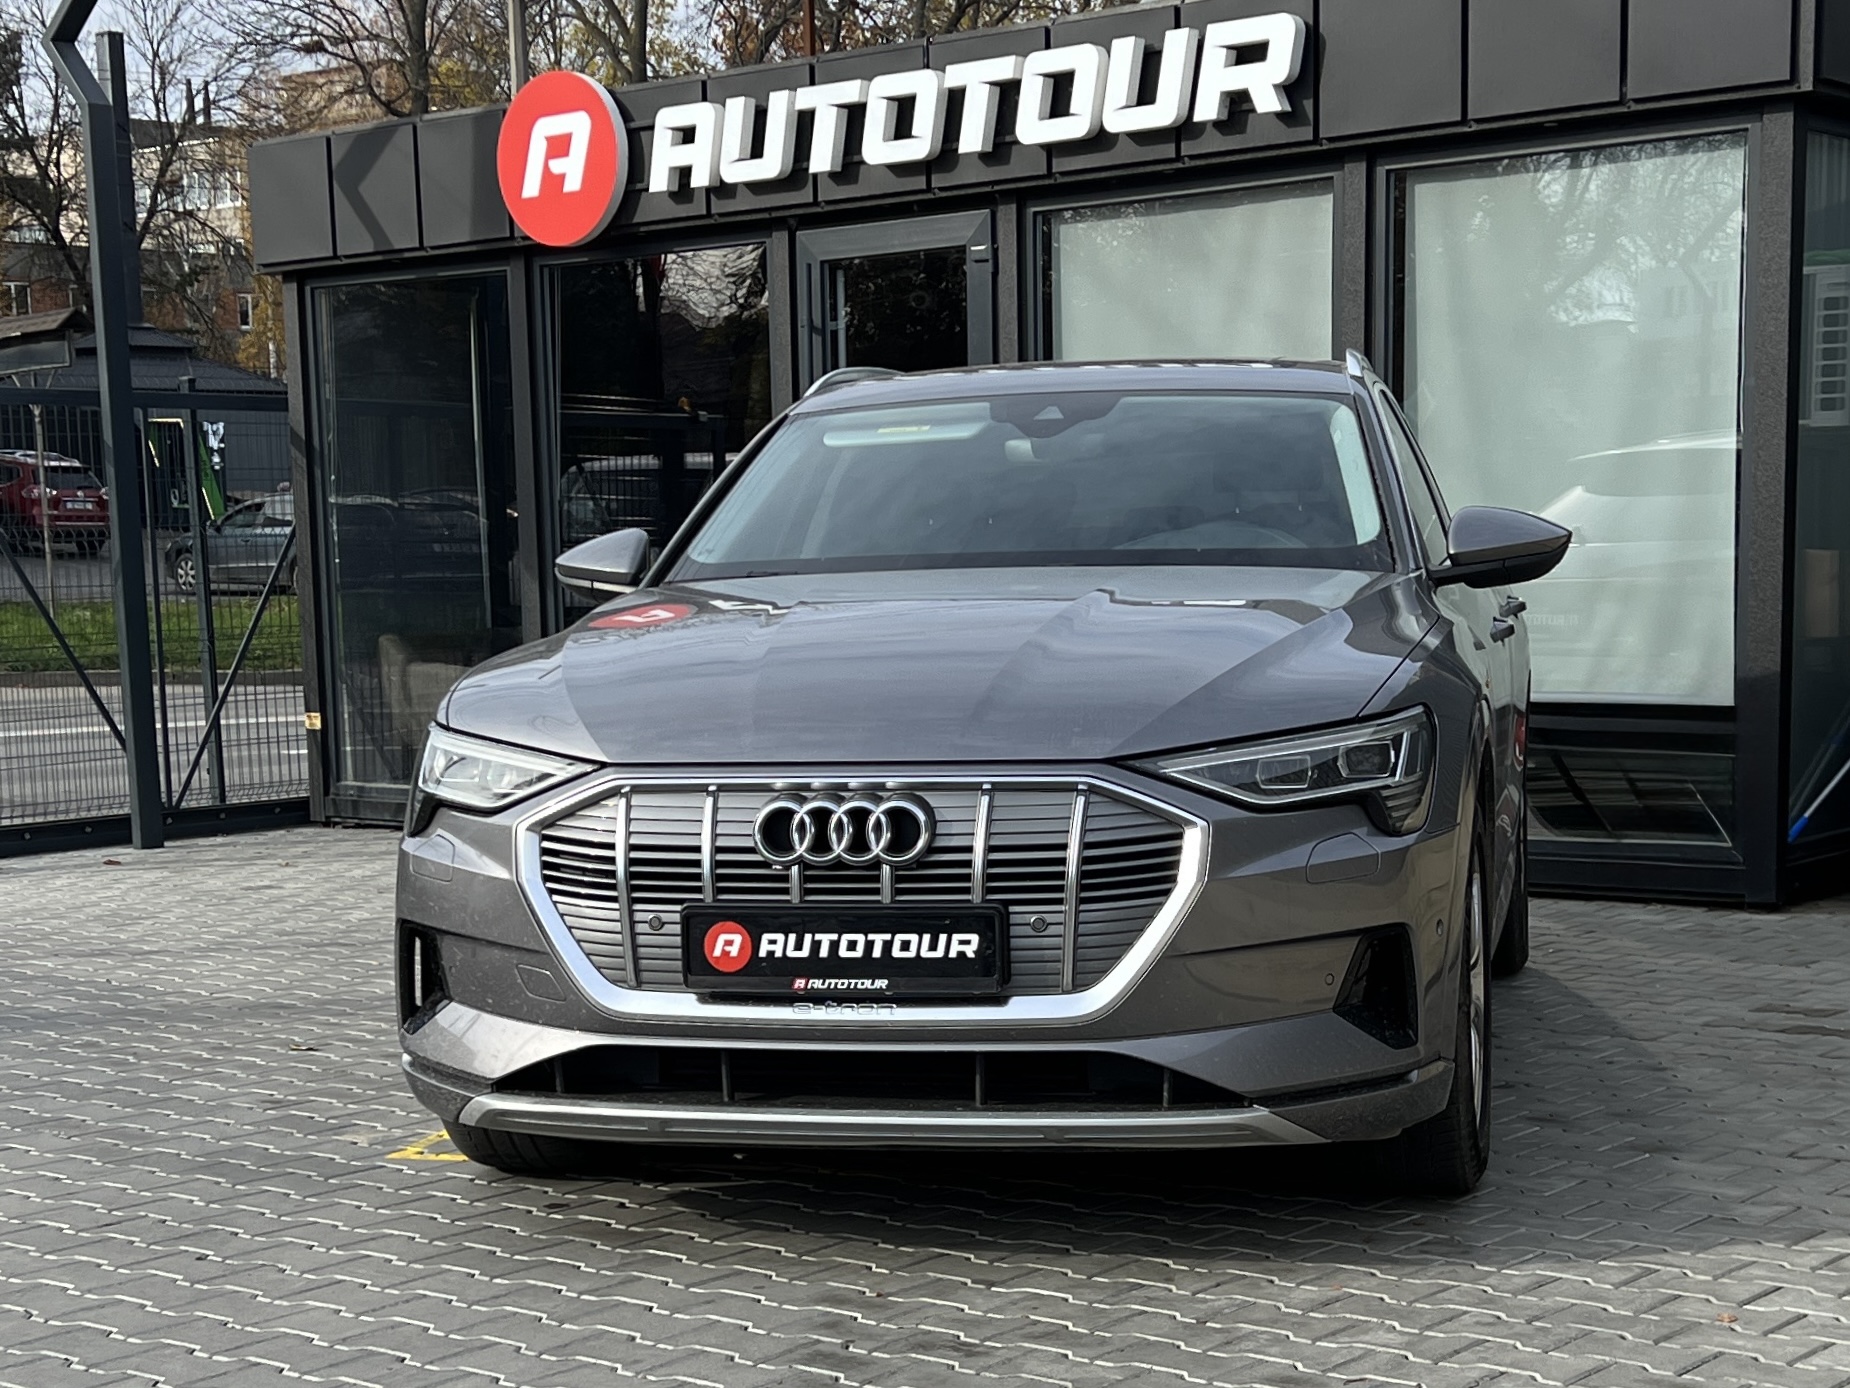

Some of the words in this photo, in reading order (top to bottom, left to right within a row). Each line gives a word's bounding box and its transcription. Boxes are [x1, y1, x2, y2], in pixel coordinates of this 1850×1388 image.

[649, 12, 1306, 193] AUTOTOUR
[758, 933, 980, 958] AUTOTOUR
[807, 979, 888, 989] AUTOTOUR
[792, 1001, 897, 1016] e-tron
